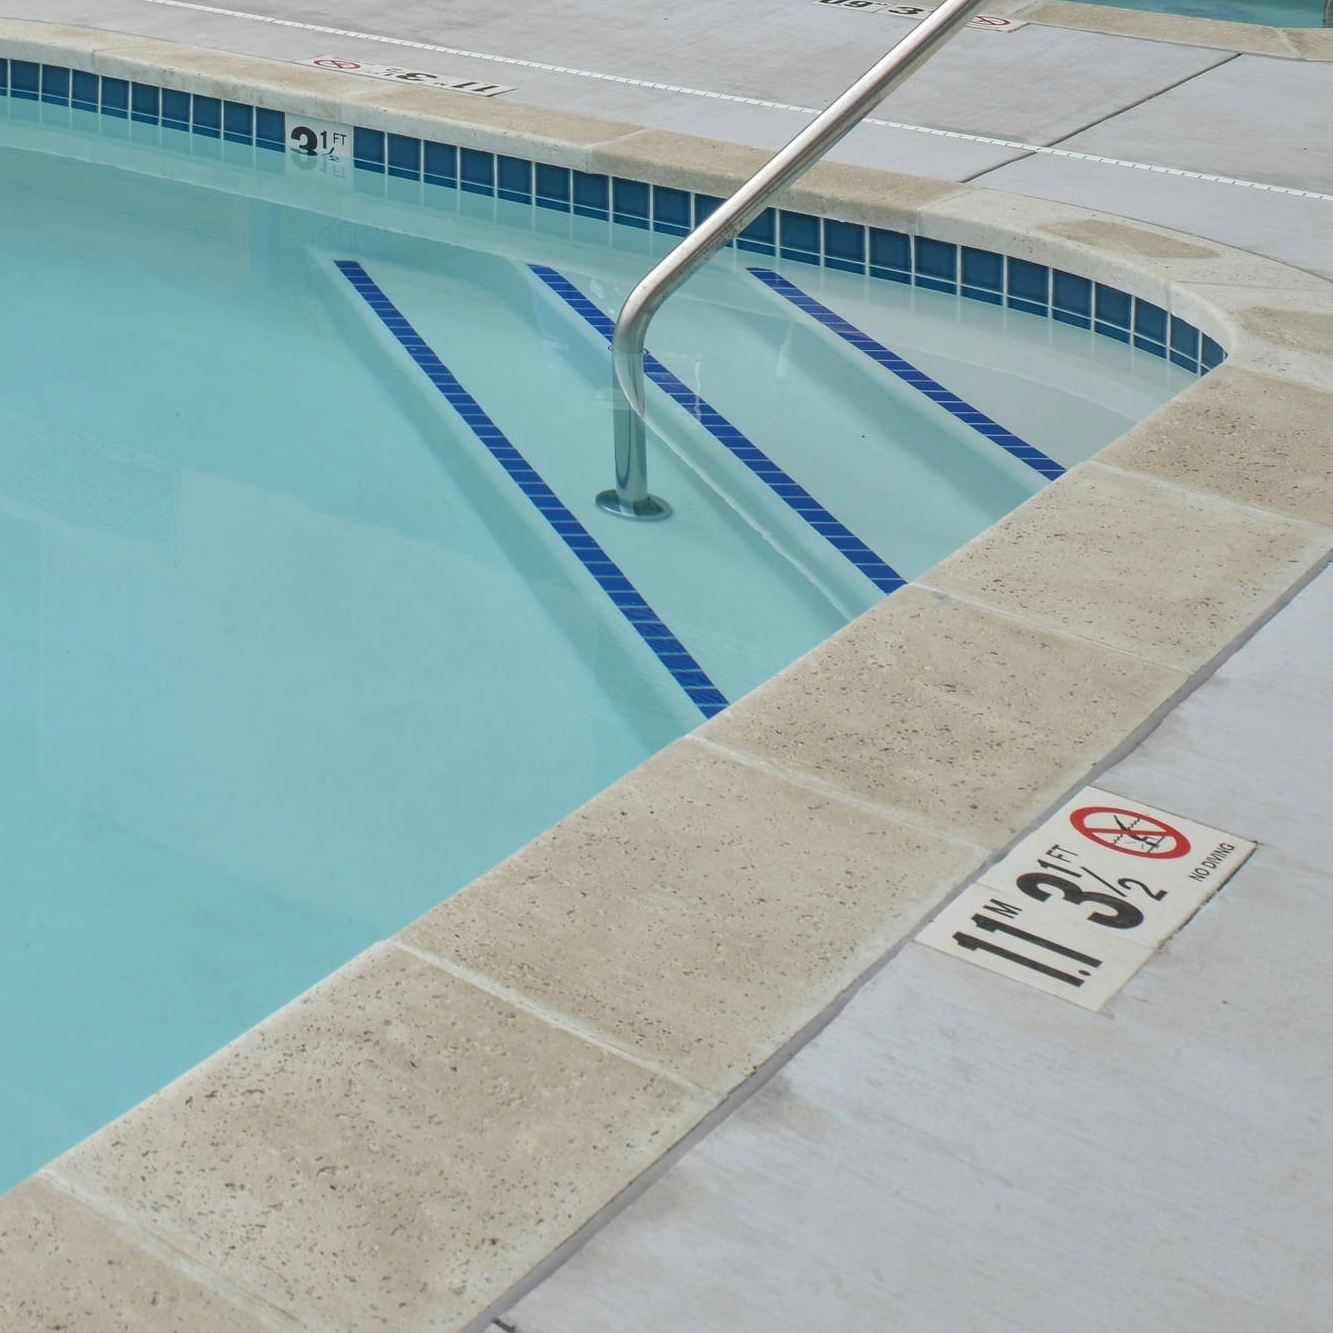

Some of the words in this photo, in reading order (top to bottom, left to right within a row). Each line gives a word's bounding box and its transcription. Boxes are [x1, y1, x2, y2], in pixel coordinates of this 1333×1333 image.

[290, 126, 318, 156] 3
[333, 132, 347, 146] FT
[983, 898, 1022, 919] M
[1046, 844, 1080, 864] FT
[1188, 867, 1211, 882] NO
[1204, 842, 1235, 873] DIVING
